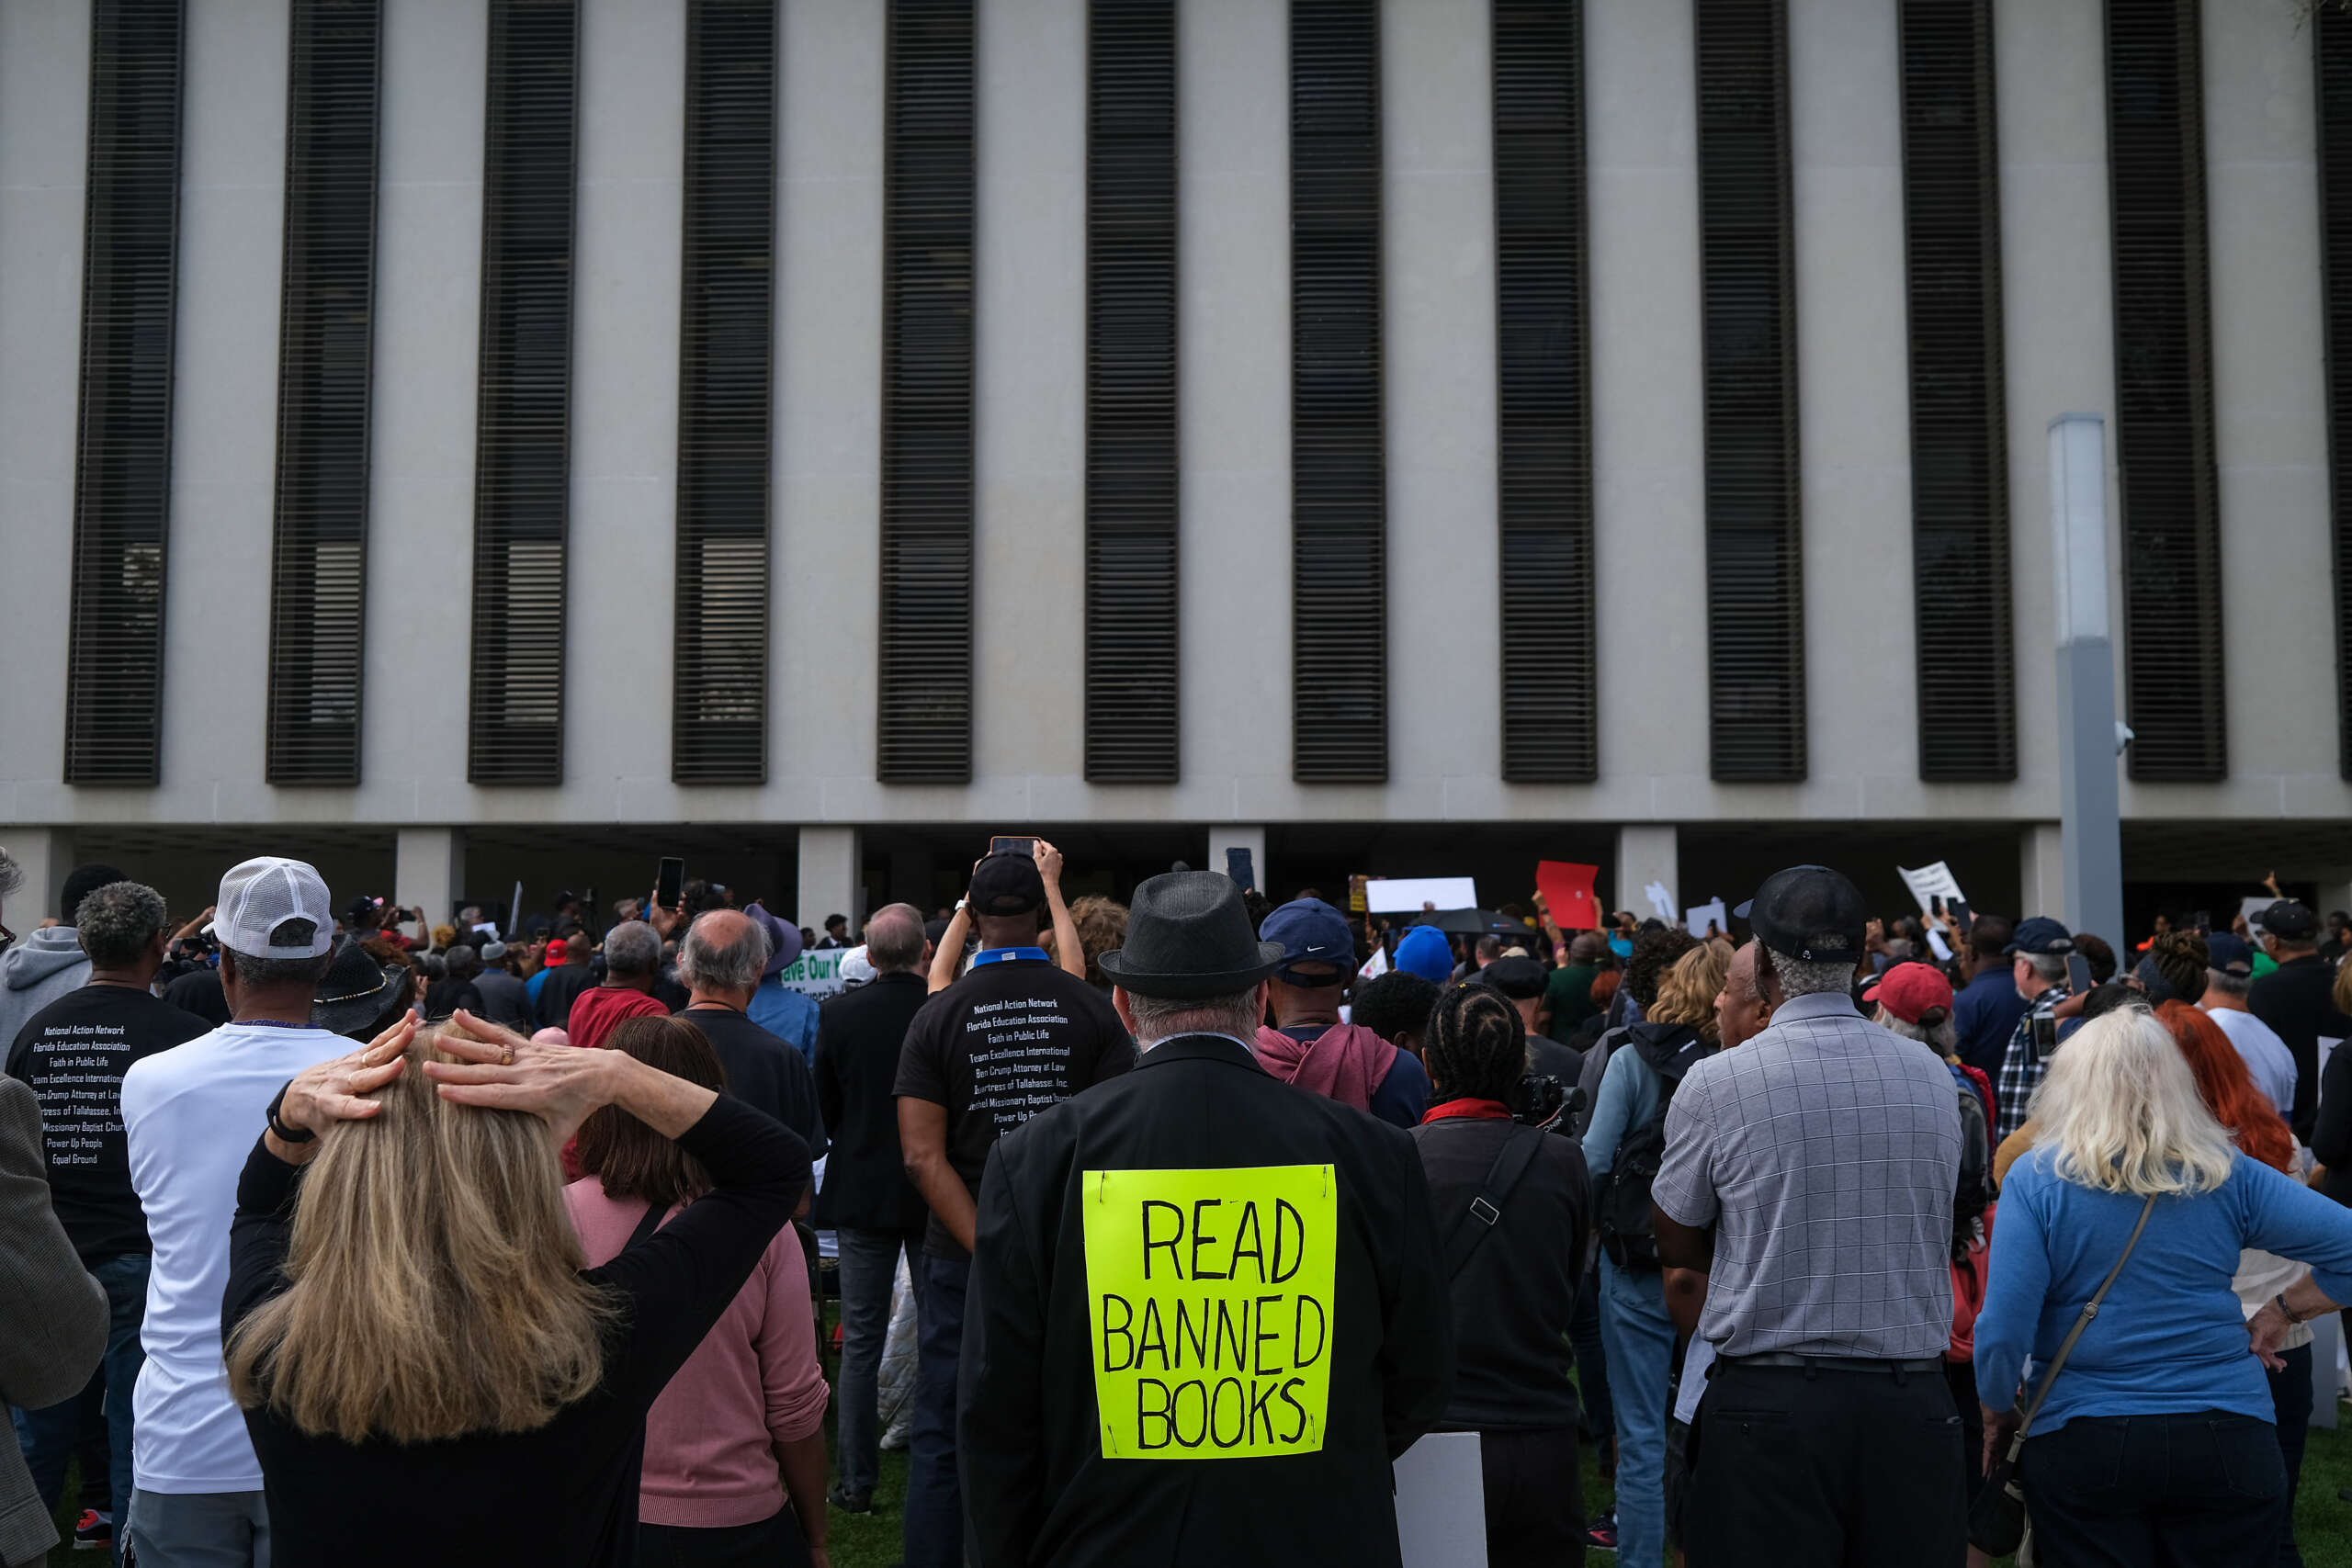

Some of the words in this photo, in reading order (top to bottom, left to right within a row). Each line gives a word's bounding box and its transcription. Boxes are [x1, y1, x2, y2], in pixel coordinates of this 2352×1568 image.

[783, 959, 805, 981] ave
[808, 954, 831, 980] Our
[974, 1000, 1003, 1014] National
[1004, 999, 1026, 1010] Action
[1028, 998, 1058, 1008] Network
[967, 1019, 991, 1032] Florida
[992, 1016, 1026, 1027] Education
[1028, 1014, 1069, 1024] Association
[43, 1025, 71, 1036] National
[73, 1025, 93, 1034] Action
[95, 1024, 125, 1035] Network
[988, 1032, 1004, 1043] Faith
[1006, 1032, 1012, 1042] in
[1013, 1030, 1035, 1041] Public
[1036, 1029, 1049, 1040] Life
[33, 1042, 55, 1053] Florida
[57, 1041, 89, 1051] Education
[91, 1041, 130, 1051] Association
[50, 1057, 66, 1067] Faith
[67, 1057, 74, 1066] in
[75, 1056, 96, 1066] Public
[96, 1055, 108, 1066] Life
[968, 1054, 989, 1064] Team
[990, 1048, 1024, 1060] Excellence
[1026, 1046, 1070, 1056] International
[976, 1068, 989, 1078] Ben
[989, 1066, 1012, 1076] Crump
[1013, 1063, 1042, 1073] Attorney
[1044, 1063, 1050, 1071] at
[1051, 1061, 1066, 1071] Law
[50, 1073, 85, 1083] Excellence
[85, 1073, 123, 1083] Internationa
[1007, 1079, 1014, 1089] of
[71, 1089, 96, 1100] Attorney
[98, 1090, 106, 1100] at
[989, 1096, 1026, 1108] Missionary
[1027, 1094, 1053, 1105] Baptist
[62, 1105, 71, 1115] of
[74, 1105, 111, 1116] Tallahassee,
[994, 1112, 1016, 1123] Power
[1017, 1111, 1027, 1122] Up
[42, 1122, 80, 1133] Missionary
[82, 1122, 104, 1133] Baptist
[47, 1138, 70, 1148] Power
[71, 1138, 79, 1149] Up
[81, 1138, 103, 1149] People
[52, 1154, 71, 1165] Equal
[73, 1154, 97, 1164] Ground
[1141, 1197, 1305, 1284] READ
[1102, 1293, 1326, 1376] BANNED
[1137, 1376, 1306, 1450] BOOKS
